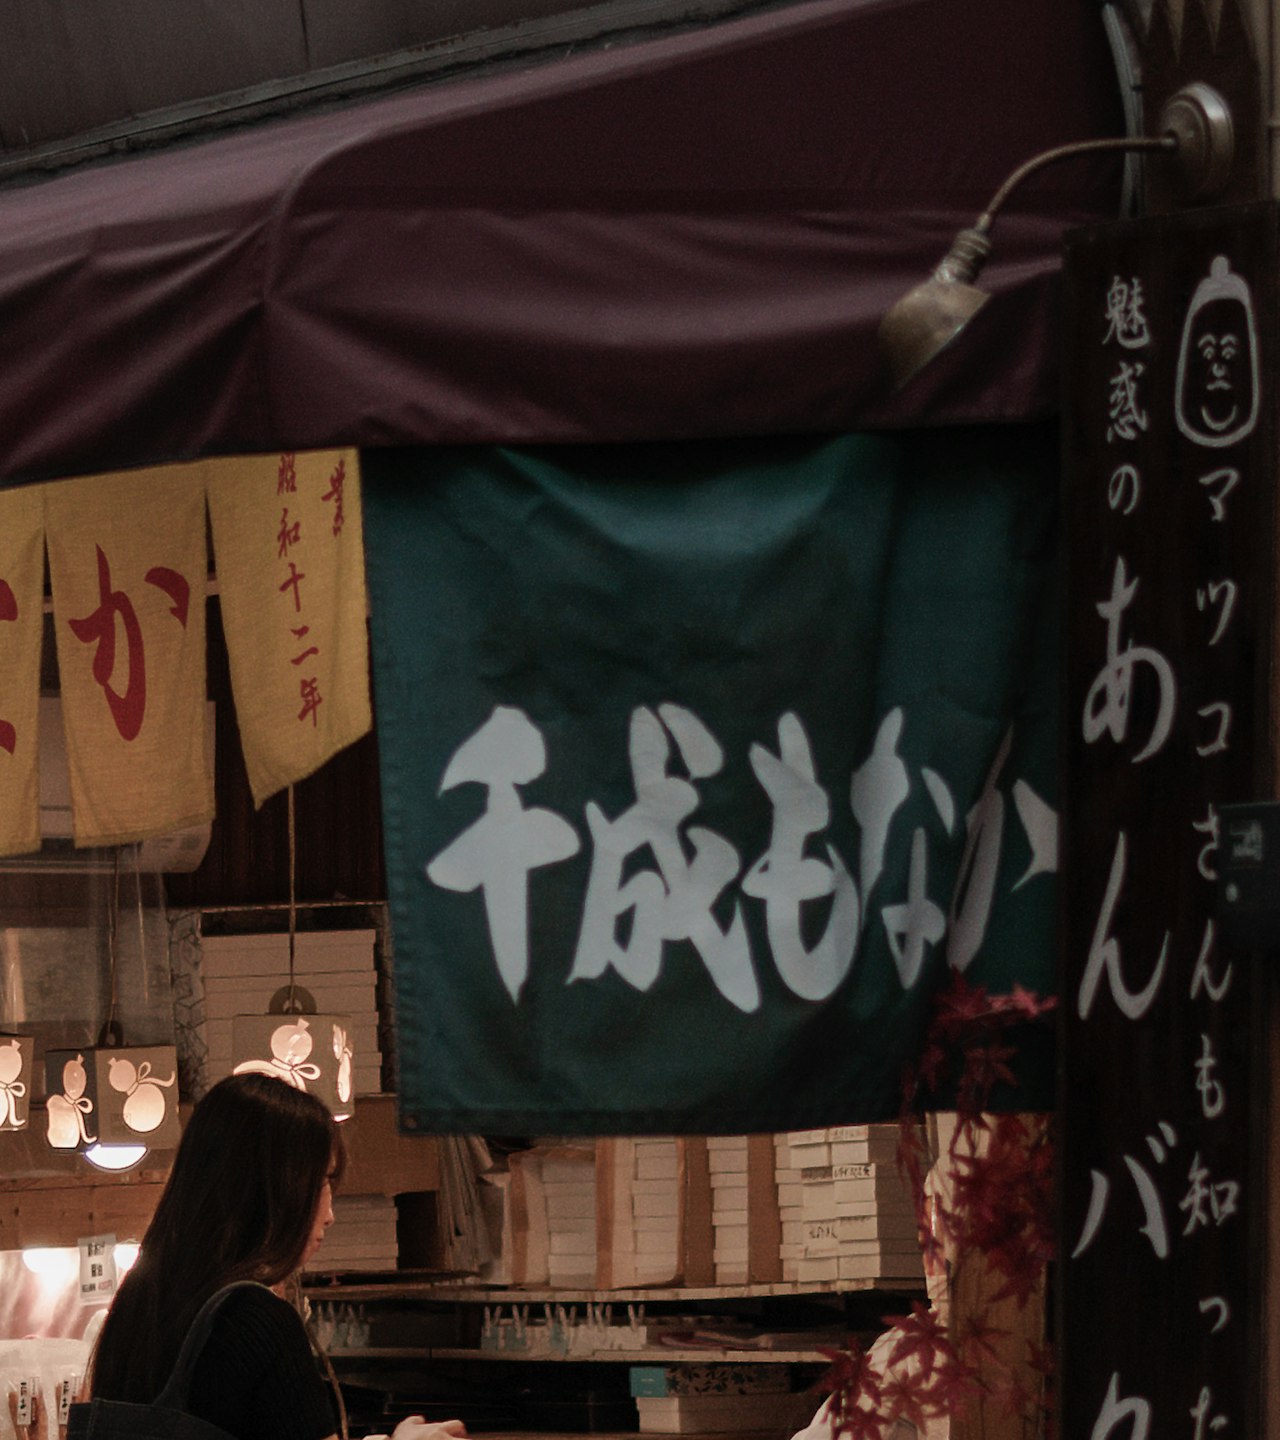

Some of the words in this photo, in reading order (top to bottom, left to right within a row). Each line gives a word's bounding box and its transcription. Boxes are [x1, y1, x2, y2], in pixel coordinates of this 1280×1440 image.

[425, 700, 1060, 1016] 千成もなか
